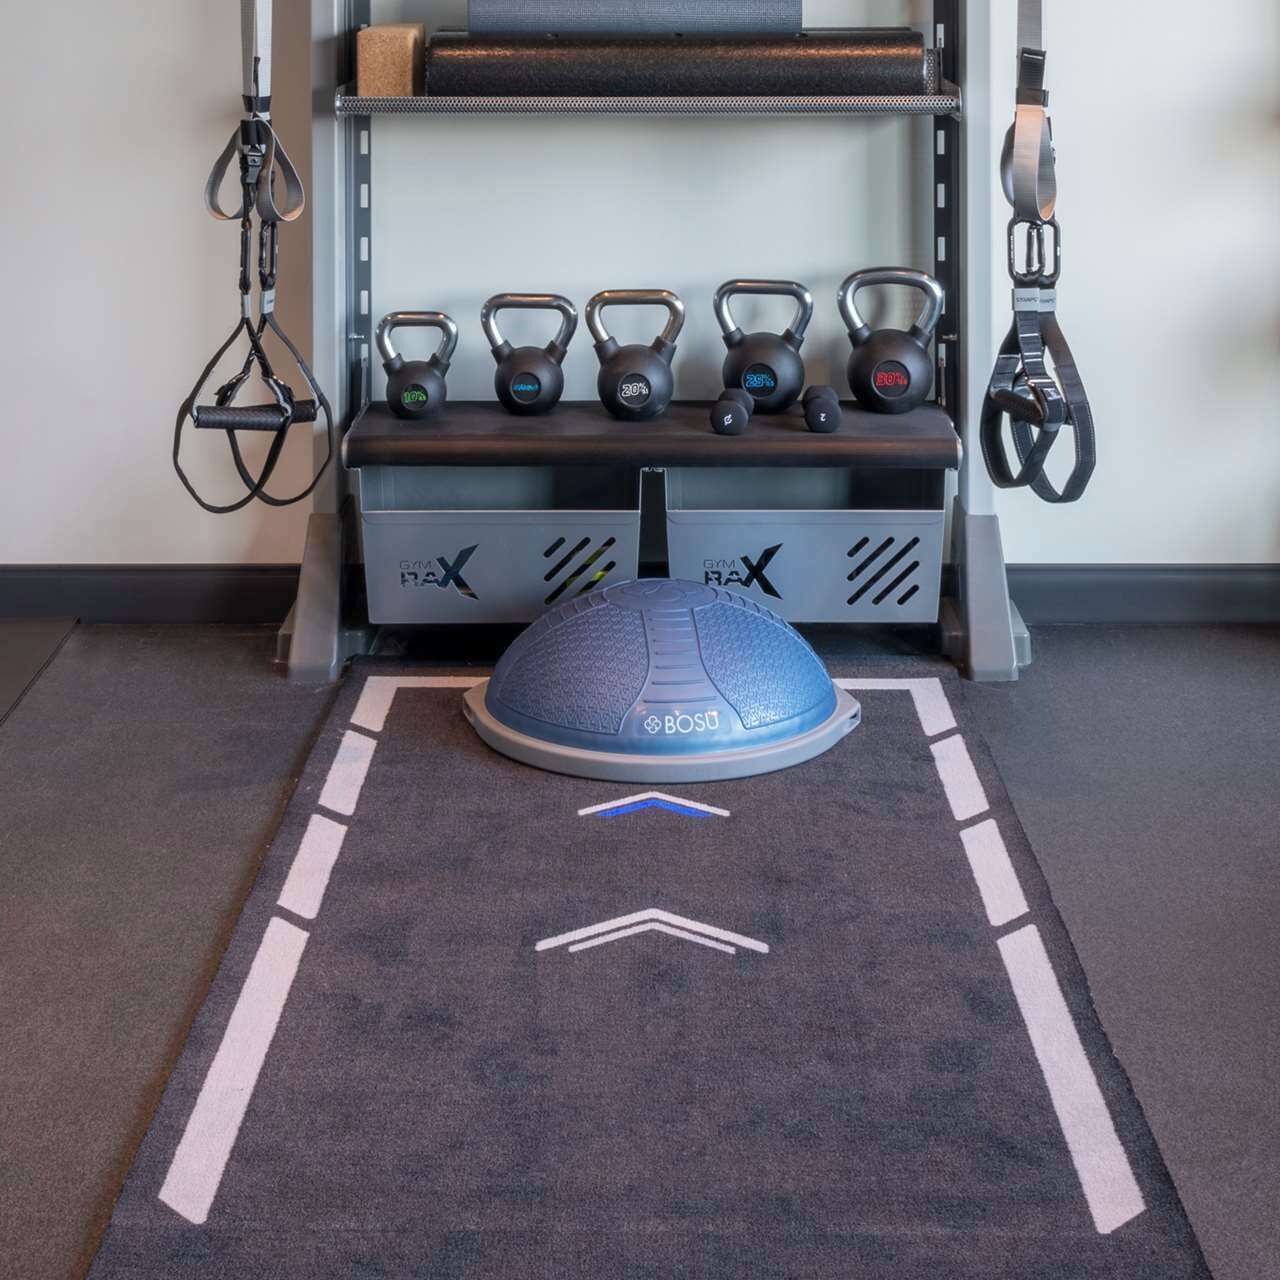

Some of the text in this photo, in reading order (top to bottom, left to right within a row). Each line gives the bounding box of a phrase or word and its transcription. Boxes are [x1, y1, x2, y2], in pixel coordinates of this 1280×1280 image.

[400, 559, 433, 570] GYM
[703, 559, 736, 569] GYM
[664, 711, 720, 735] BOSU
